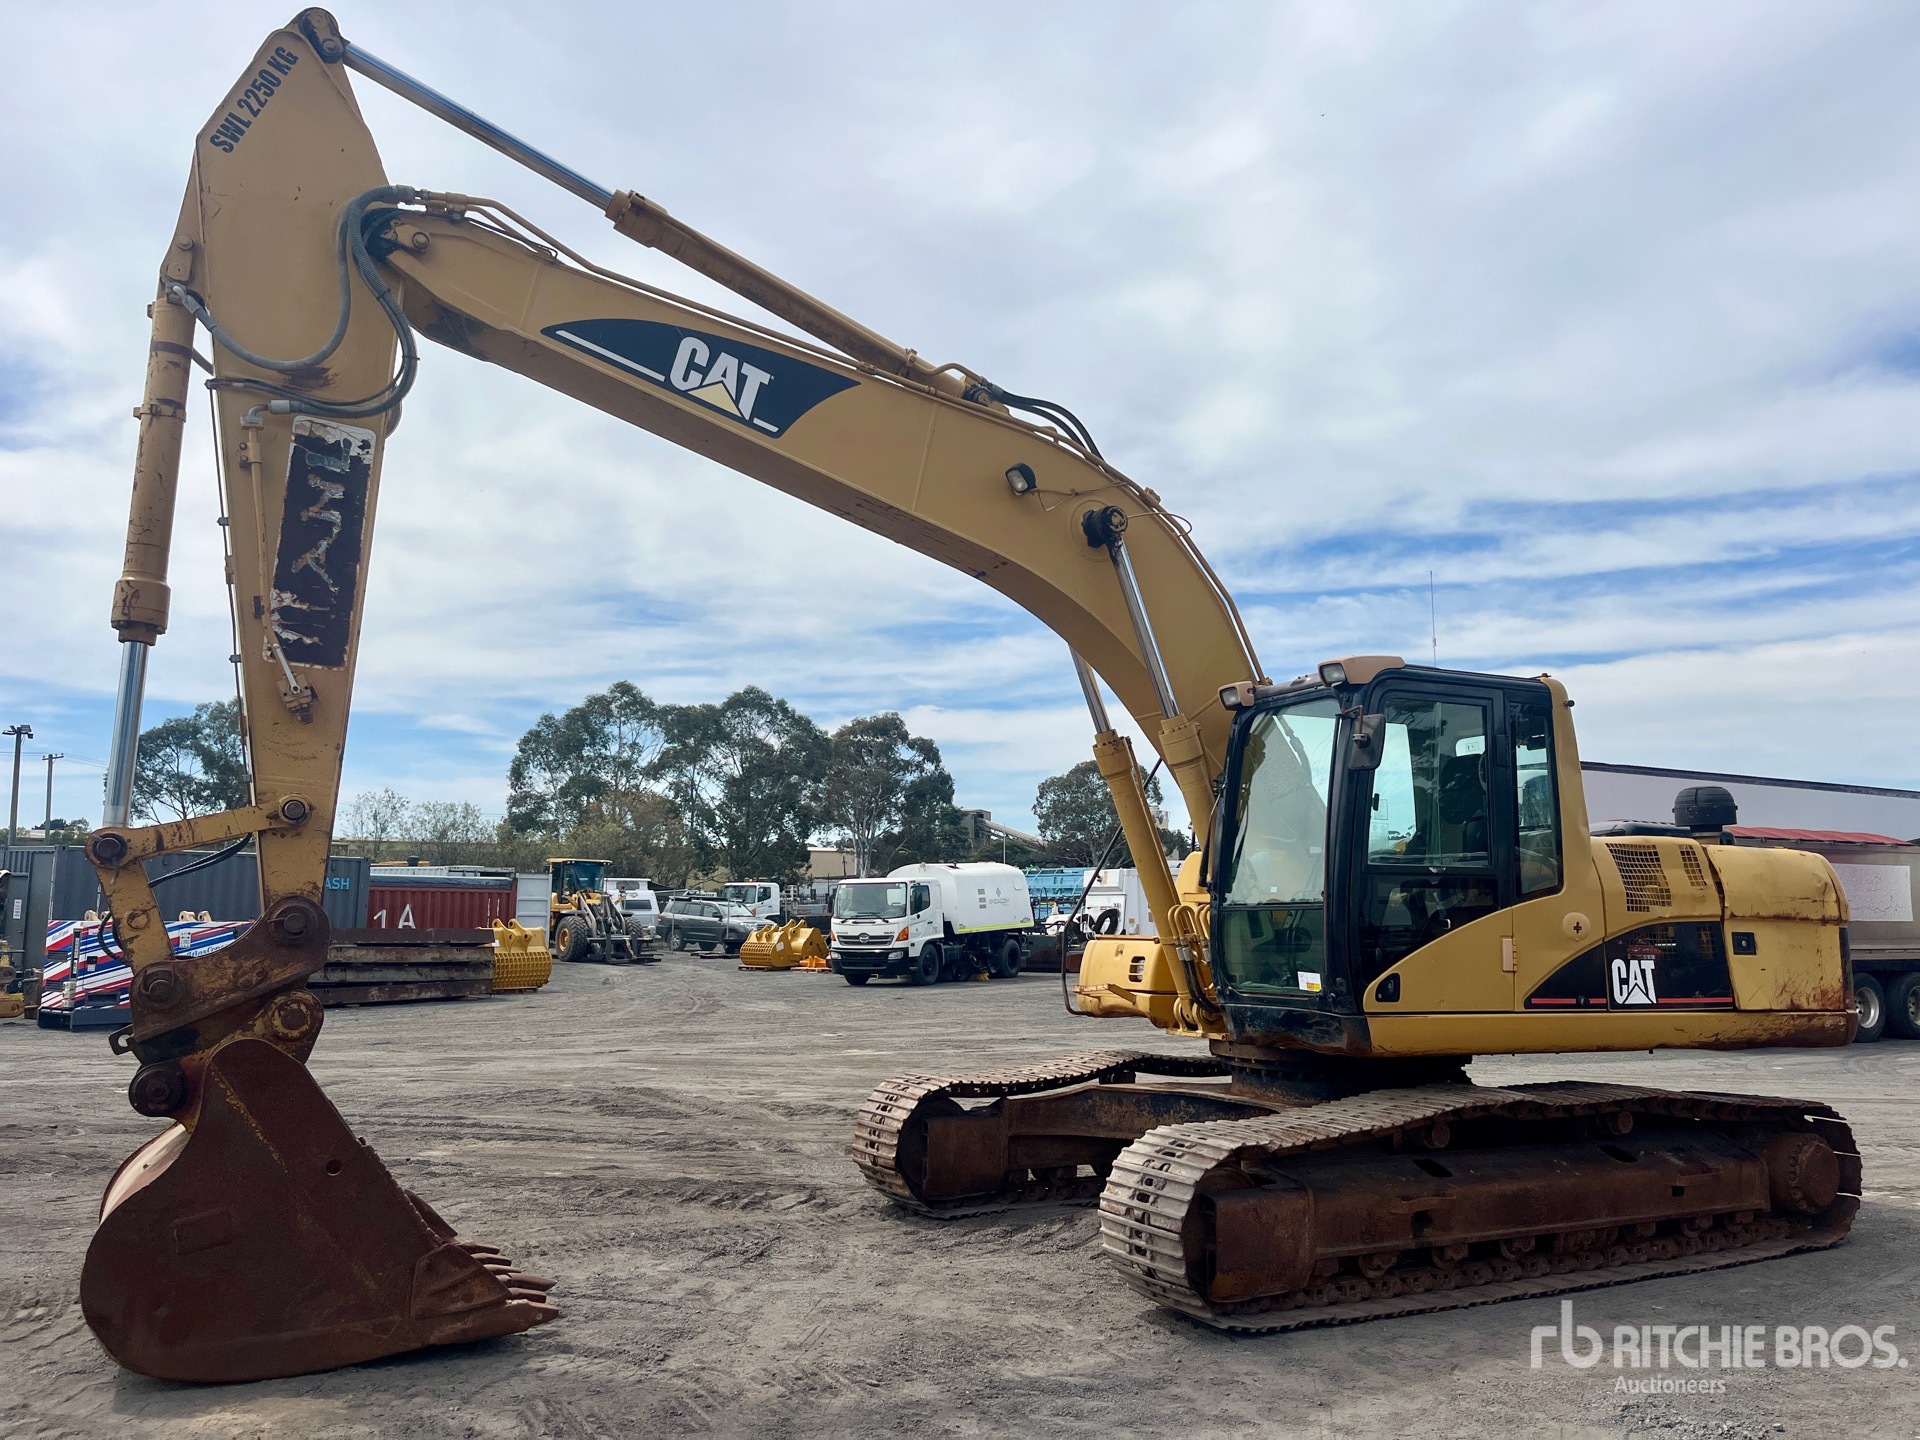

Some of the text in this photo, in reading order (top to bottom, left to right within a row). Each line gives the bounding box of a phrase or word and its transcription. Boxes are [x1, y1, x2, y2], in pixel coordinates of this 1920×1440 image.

[210, 46, 299, 153] SWL 2250 KG
[669, 336, 771, 421] CAT
[1611, 958, 1657, 1005] CAT
